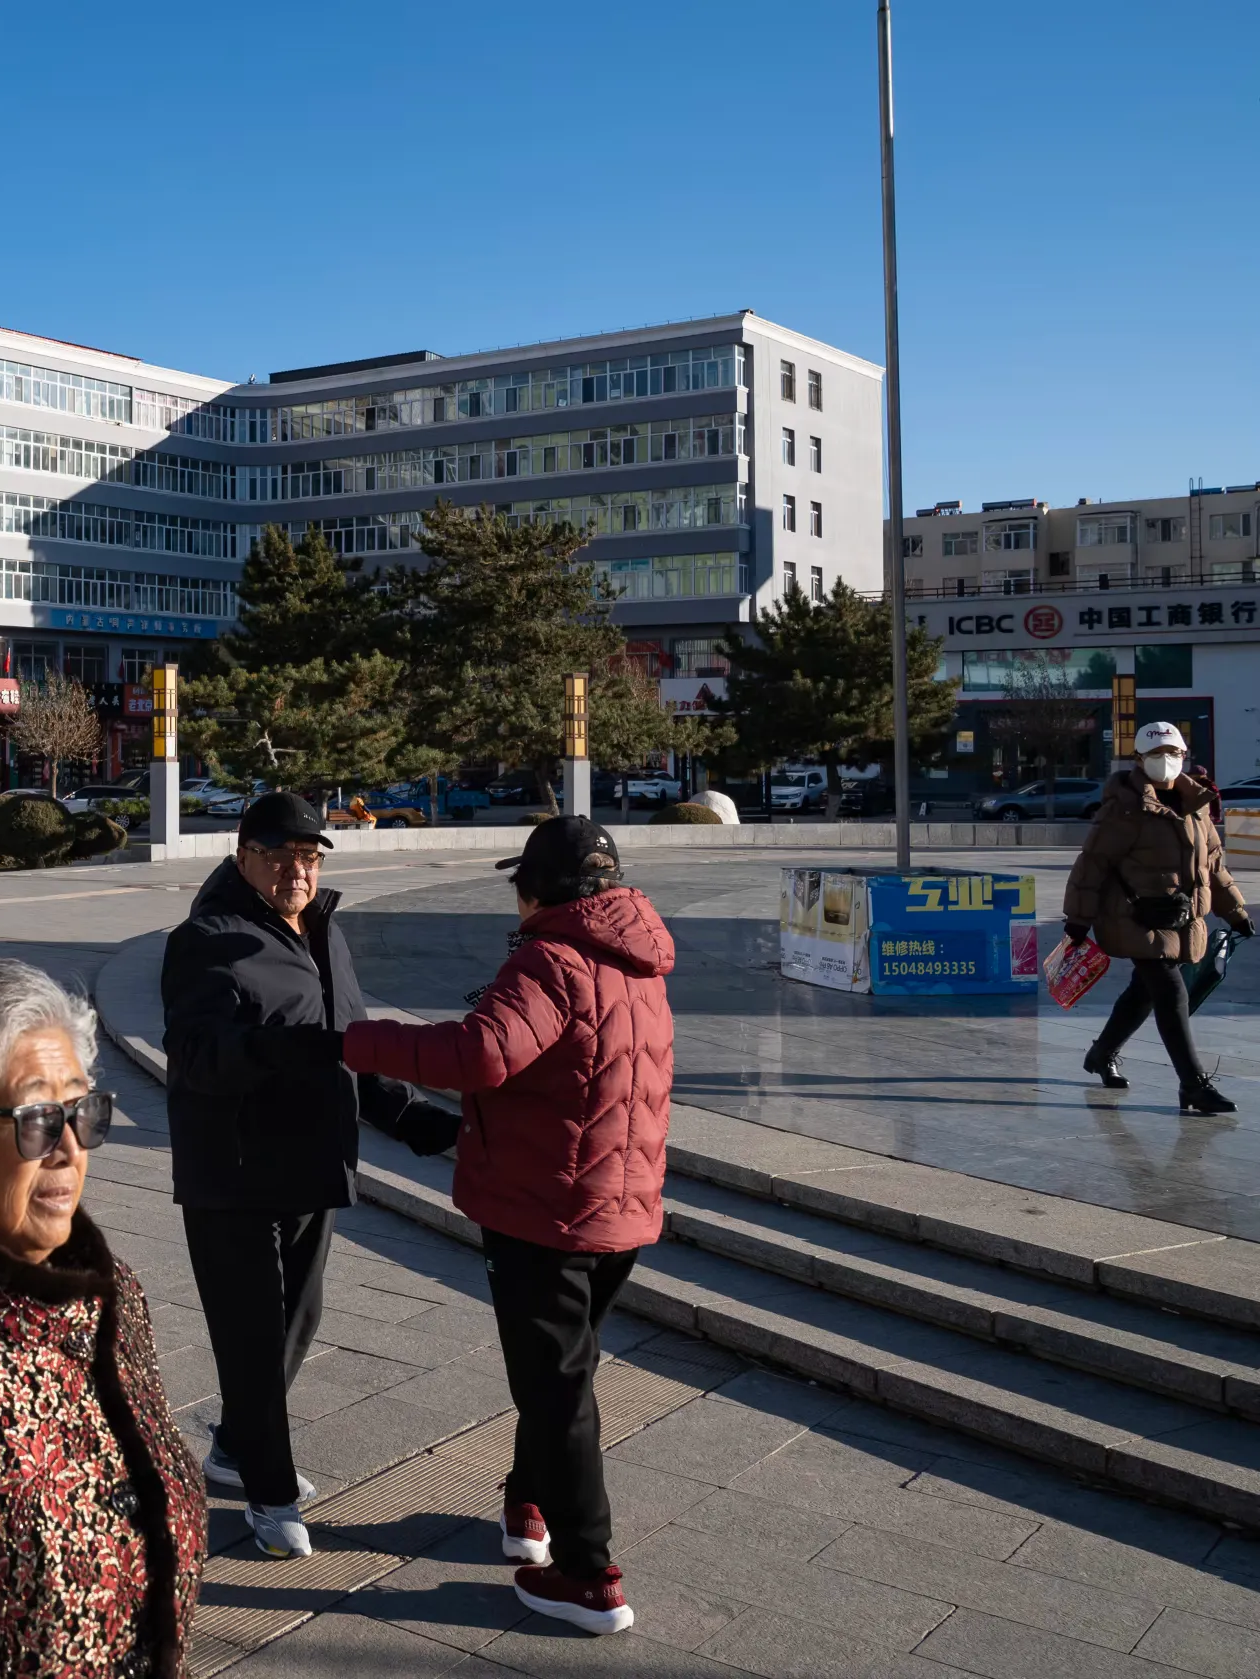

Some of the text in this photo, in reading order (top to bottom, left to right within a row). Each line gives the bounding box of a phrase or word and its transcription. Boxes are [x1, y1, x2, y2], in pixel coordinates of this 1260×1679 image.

[948, 614, 1015, 636] ICBC
[1077, 600, 1258, 632] 中国工商银行
[883, 961, 976, 976] 15048493335
